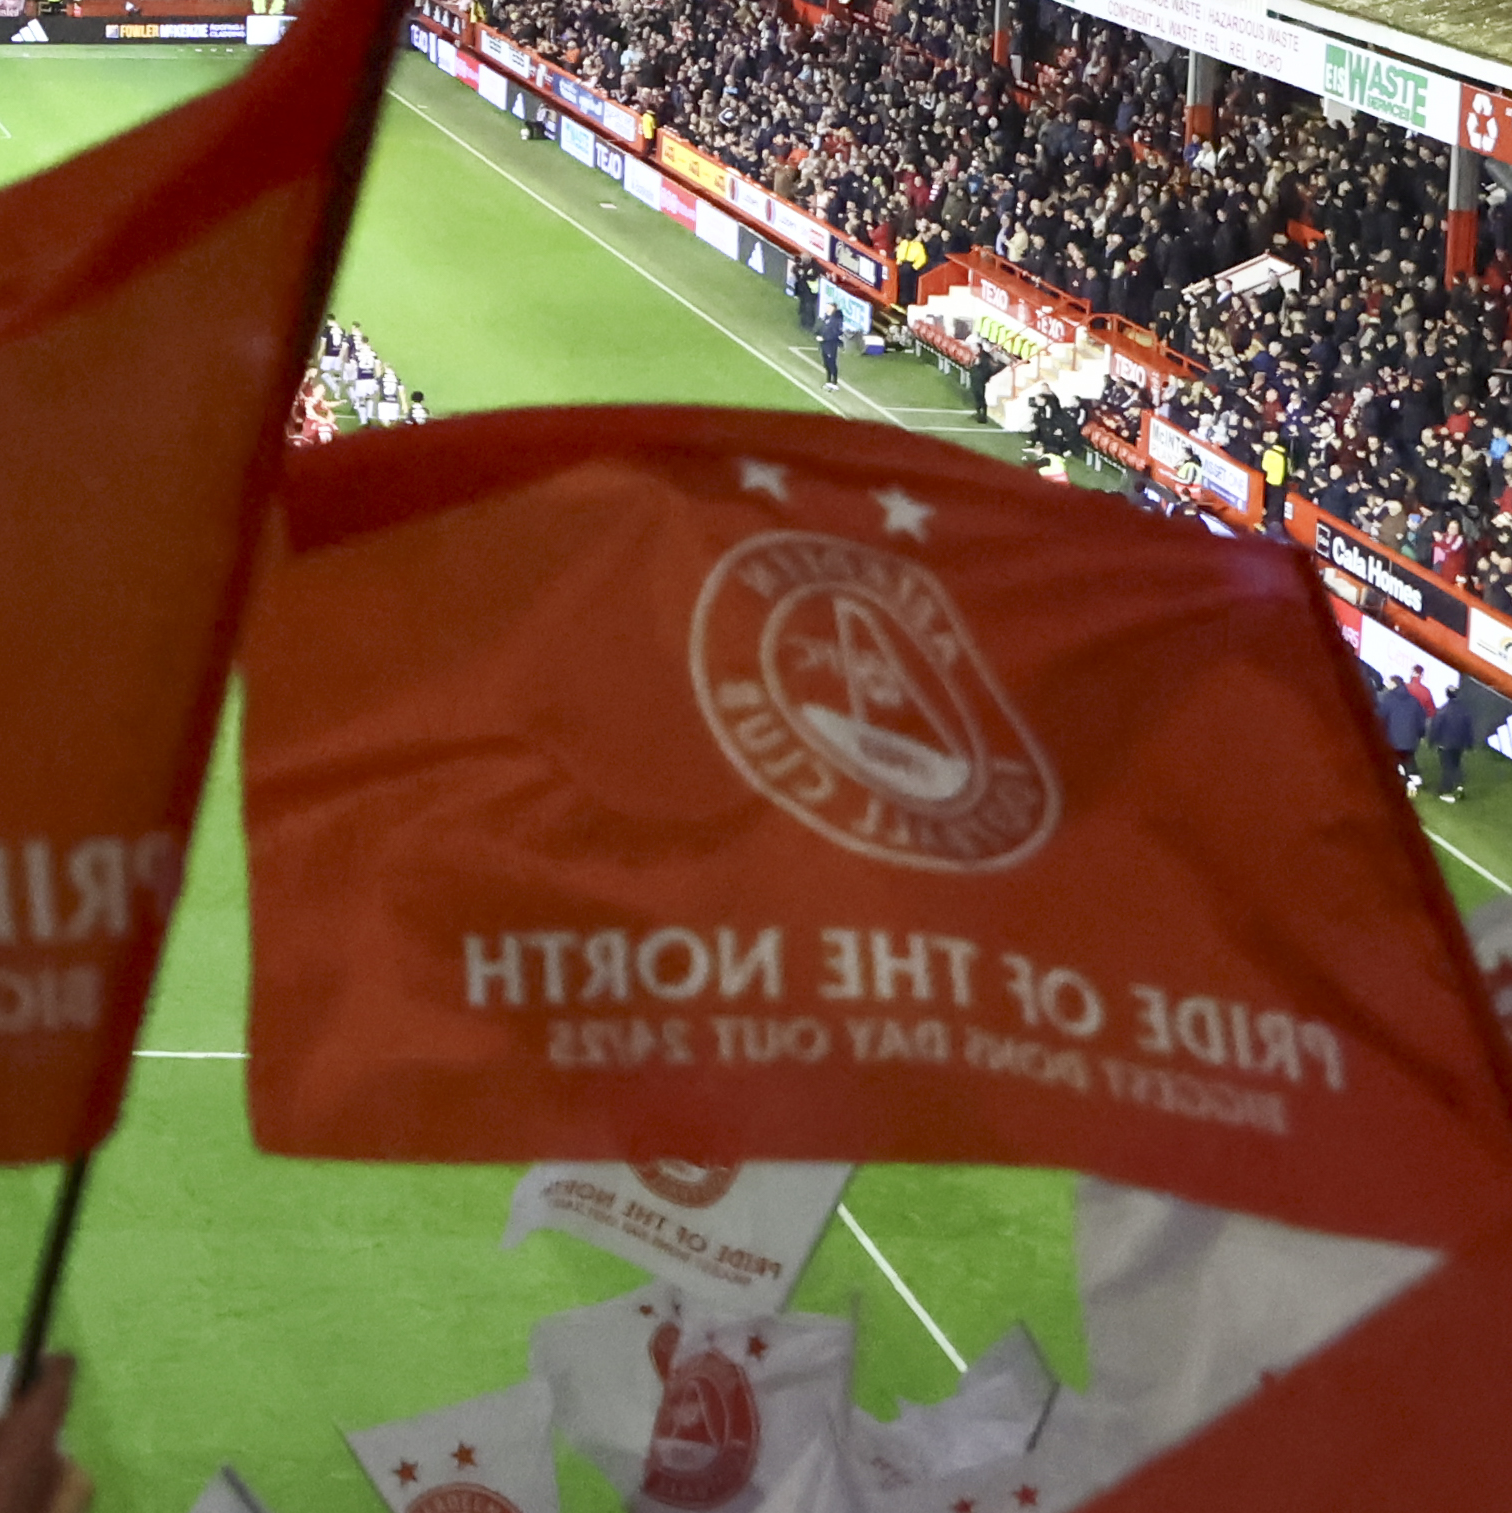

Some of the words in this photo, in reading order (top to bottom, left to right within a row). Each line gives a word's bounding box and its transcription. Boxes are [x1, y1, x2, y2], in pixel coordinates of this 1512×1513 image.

[120, 24, 159, 38] FOWLER
[1168, 19, 1198, 45] WASTE
[1229, 41, 1247, 62] REL
[1255, 49, 1283, 73] RORO
[1208, 8, 1265, 41] HAZARDOUS
[1266, 27, 1300, 53] WASTE
[1325, 62, 1345, 97] EIS
[1345, 50, 1429, 128] WASTE
[980, 278, 1010, 311] TEXO
[1035, 308, 1066, 341] TEXO
[1113, 353, 1147, 389] TEXO
[1331, 536, 1367, 580] Cala
[1367, 554, 1423, 613] Homes
